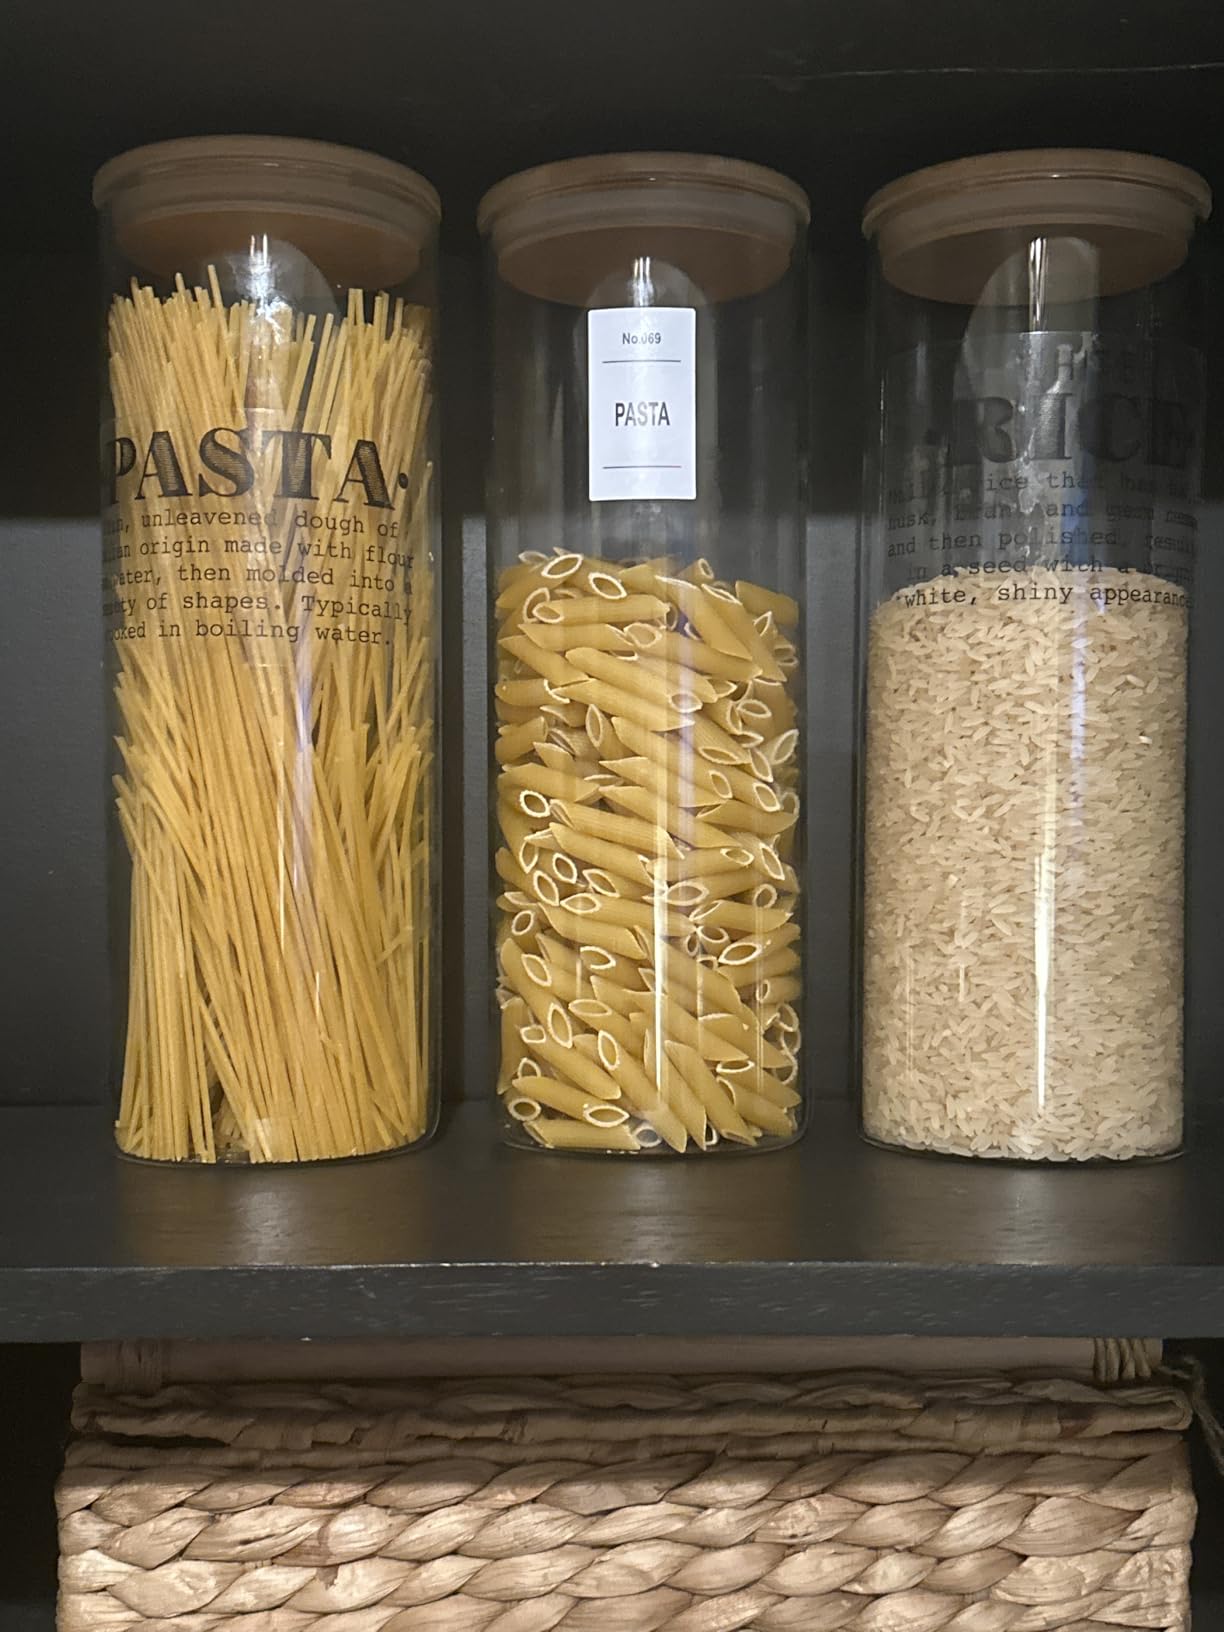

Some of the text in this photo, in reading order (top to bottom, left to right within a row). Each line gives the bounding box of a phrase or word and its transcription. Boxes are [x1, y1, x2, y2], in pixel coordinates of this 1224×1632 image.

[622, 332, 661, 345] No.069
[614, 401, 670, 427] PASTA
[1045, 498, 1091, 518] and
[142, 508, 278, 527] unleavened
[295, 510, 364, 536] dough
[377, 521, 399, 538] of
[139, 536, 210, 558] origin
[224, 536, 282, 554] made
[298, 539, 351, 559] with
[365, 545, 414, 569] flour
[887, 536, 916, 558] and
[929, 531, 982, 550] then
[113, 568, 162, 586] ater,
[178, 563, 231, 581] then
[246, 563, 334, 585] molded
[349, 569, 395, 592] into
[968, 555, 1027, 575] seed
[146, 592, 168, 610] of
[183, 591, 281, 616] shapes.
[301, 595, 412, 626] Typically
[905, 587, 976, 608] white,
[997, 582, 1074, 604] shiny
[158, 619, 181, 638] in
[196, 618, 300, 643] boiling
[316, 625, 391, 646] water.
